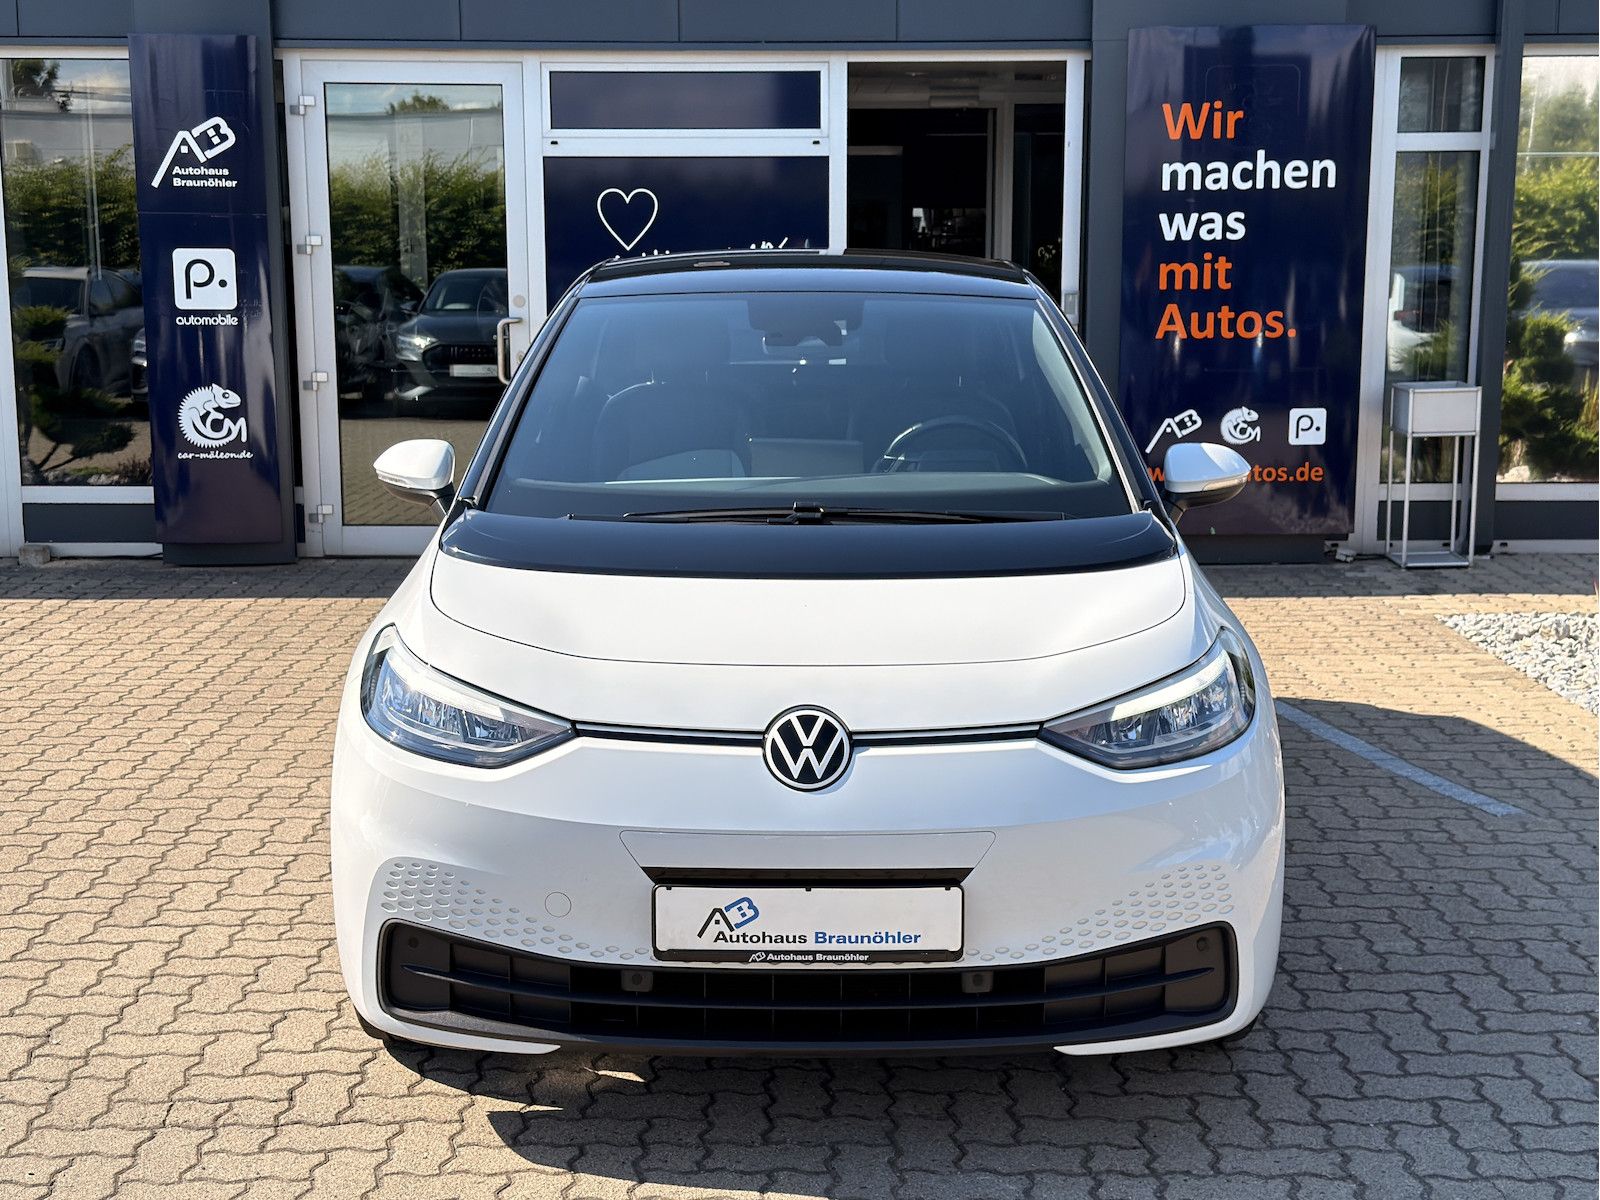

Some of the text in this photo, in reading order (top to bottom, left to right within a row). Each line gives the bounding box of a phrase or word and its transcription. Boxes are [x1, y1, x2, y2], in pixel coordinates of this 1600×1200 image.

[1162, 100, 1243, 140] Wir
[172, 166, 229, 175] Autohaus
[1162, 149, 1336, 191] machen
[173, 178, 237, 188] Braunöhler
[1159, 211, 1246, 241] was
[1159, 252, 1232, 290] mit
[176, 314, 239, 326] automobile
[1155, 303, 1296, 339] Autos.
[713, 931, 921, 944] Autohaus Braunöhler
[816, 953, 869, 961] Braunöhler
